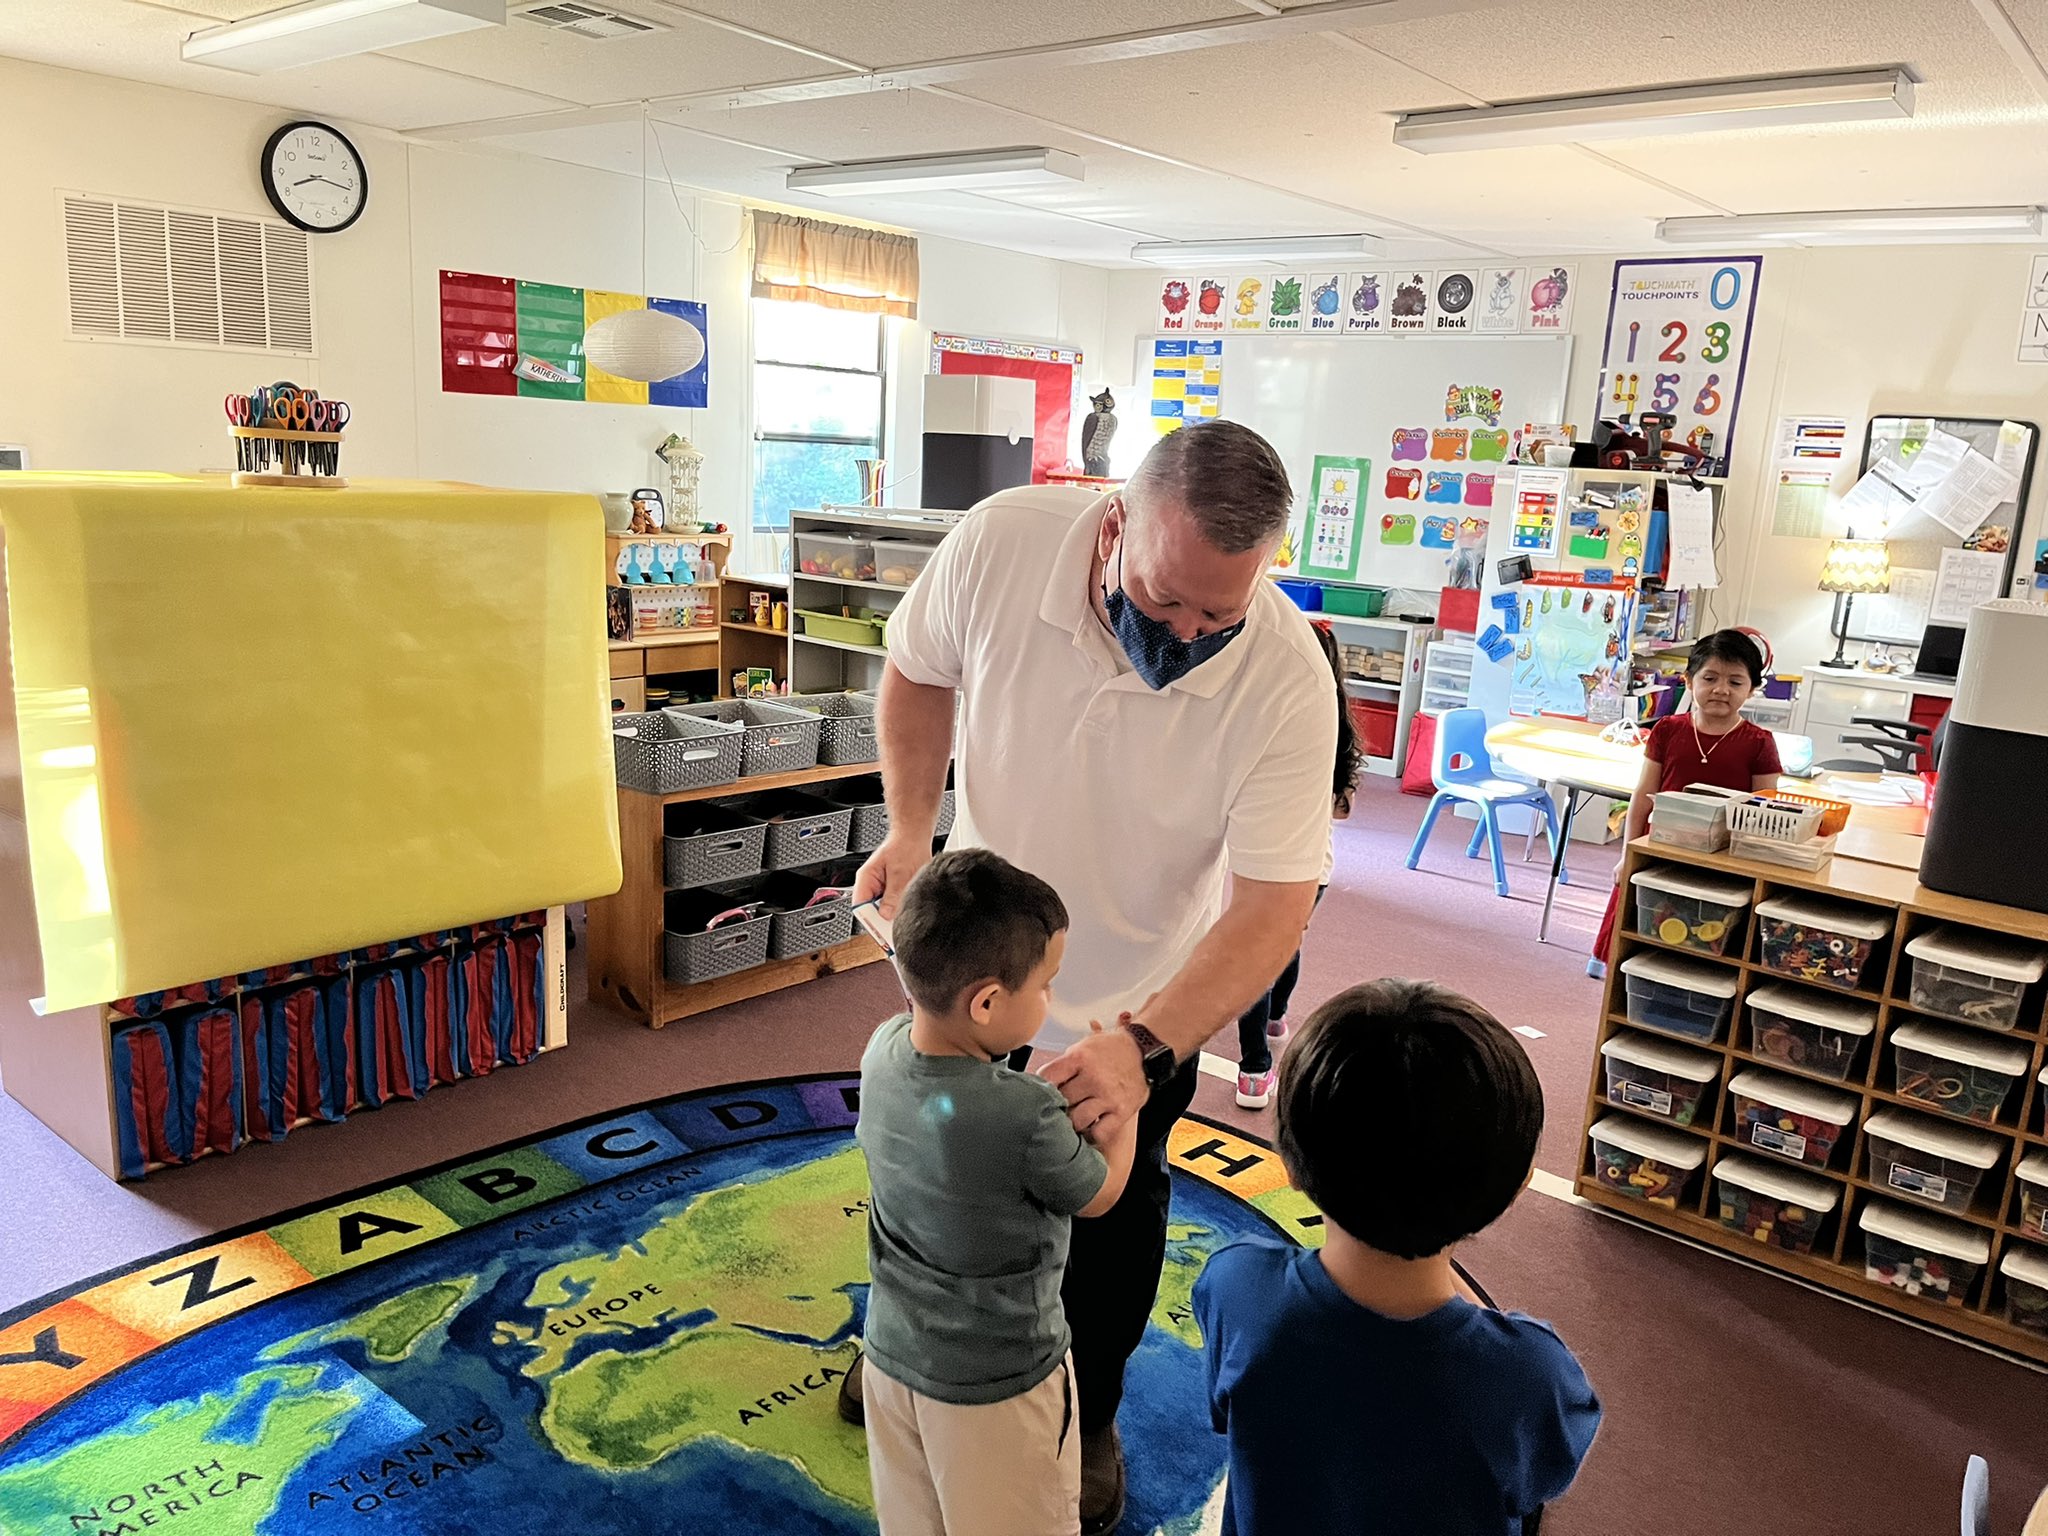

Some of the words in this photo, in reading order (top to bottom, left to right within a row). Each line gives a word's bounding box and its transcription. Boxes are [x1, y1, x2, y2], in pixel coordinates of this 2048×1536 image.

[296, 138, 305, 149] 11
[311, 136, 320, 147] 12
[329, 143, 334, 154] 1
[283, 150, 297, 162] 10
[278, 167, 286, 176] 9
[341, 160, 348, 171] 2
[348, 178, 354, 188] 3
[285, 187, 291, 197] 8
[298, 202, 304, 211] 7
[343, 196, 349, 205] 4
[315, 210, 322, 219] 6
[331, 206, 338, 216] 5
[1710, 267, 1741, 310] 0
[1621, 291, 1700, 301] TOUCHPOINTS
[1164, 317, 1183, 329] Red
[1194, 320, 1224, 331] Orange
[1231, 318, 1261, 330] Yellow
[1269, 317, 1299, 329] Green
[1312, 317, 1334, 329] Blue
[1349, 317, 1380, 331] Purple
[1391, 317, 1424, 329] Brown
[1437, 316, 1467, 328] Black
[1481, 316, 1514, 328] White
[1532, 315, 1560, 328] Pink
[1627, 321, 1640, 363] 1
[1658, 321, 1688, 363] 2
[1701, 321, 1731, 364] 3
[531, 363, 568, 383] KATHERIN
[1613, 373, 1639, 414] 4
[1651, 373, 1680, 414] 5
[1693, 373, 1722, 416] 6
[1454, 403, 1495, 418] BIRDAY
[1434, 430, 1467, 440] September
[1472, 431, 1496, 440] October
[1395, 517, 1412, 526] April
[1425, 519, 1443, 529] May
[1534, 572, 1561, 583] Journeys
[1180, 1138, 1265, 1178] H
[147, 1255, 257, 1312] Z
[338, 1211, 424, 1255] A
[458, 1167, 538, 1206] B
[585, 1127, 659, 1160] C
[708, 1099, 779, 1132] D
[513, 1200, 612, 1242] ARCTIC
[616, 1167, 702, 1202] OCEAN
[548, 1283, 663, 1338] EUROPE
[738, 1366, 846, 1427] AFRICA
[308, 1415, 497, 1511] ATLANTIC
[352, 1445, 487, 1513] OCEAN
[70, 1458, 224, 1530] NORTH
[99, 1472, 264, 1536] MERICA
